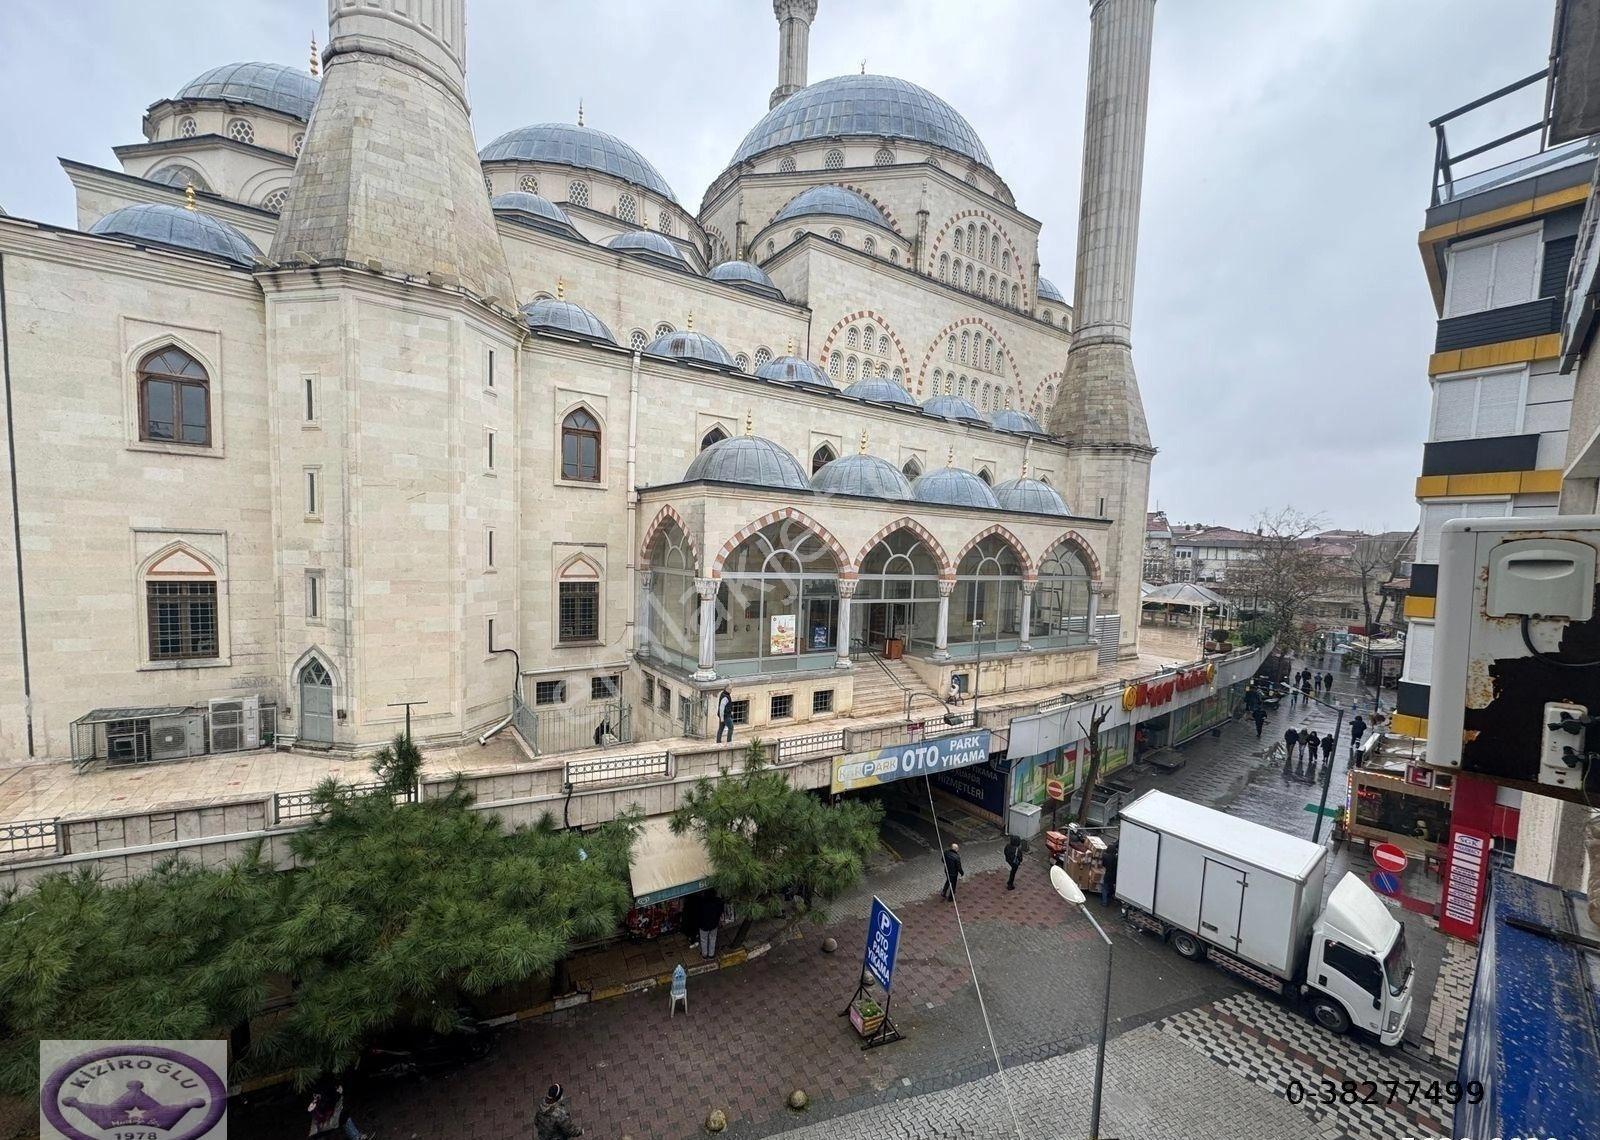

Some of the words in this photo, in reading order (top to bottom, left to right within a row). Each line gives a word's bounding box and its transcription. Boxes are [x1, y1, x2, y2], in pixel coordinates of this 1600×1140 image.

[950, 736, 980, 752] PARK
[902, 745, 939, 772] OTO
[941, 749, 985, 768] YIKAMA
[880, 913, 890, 931] P
[875, 931, 889, 950] OTO
[872, 940, 888, 965] PARK
[867, 947, 890, 982] YIKAMA
